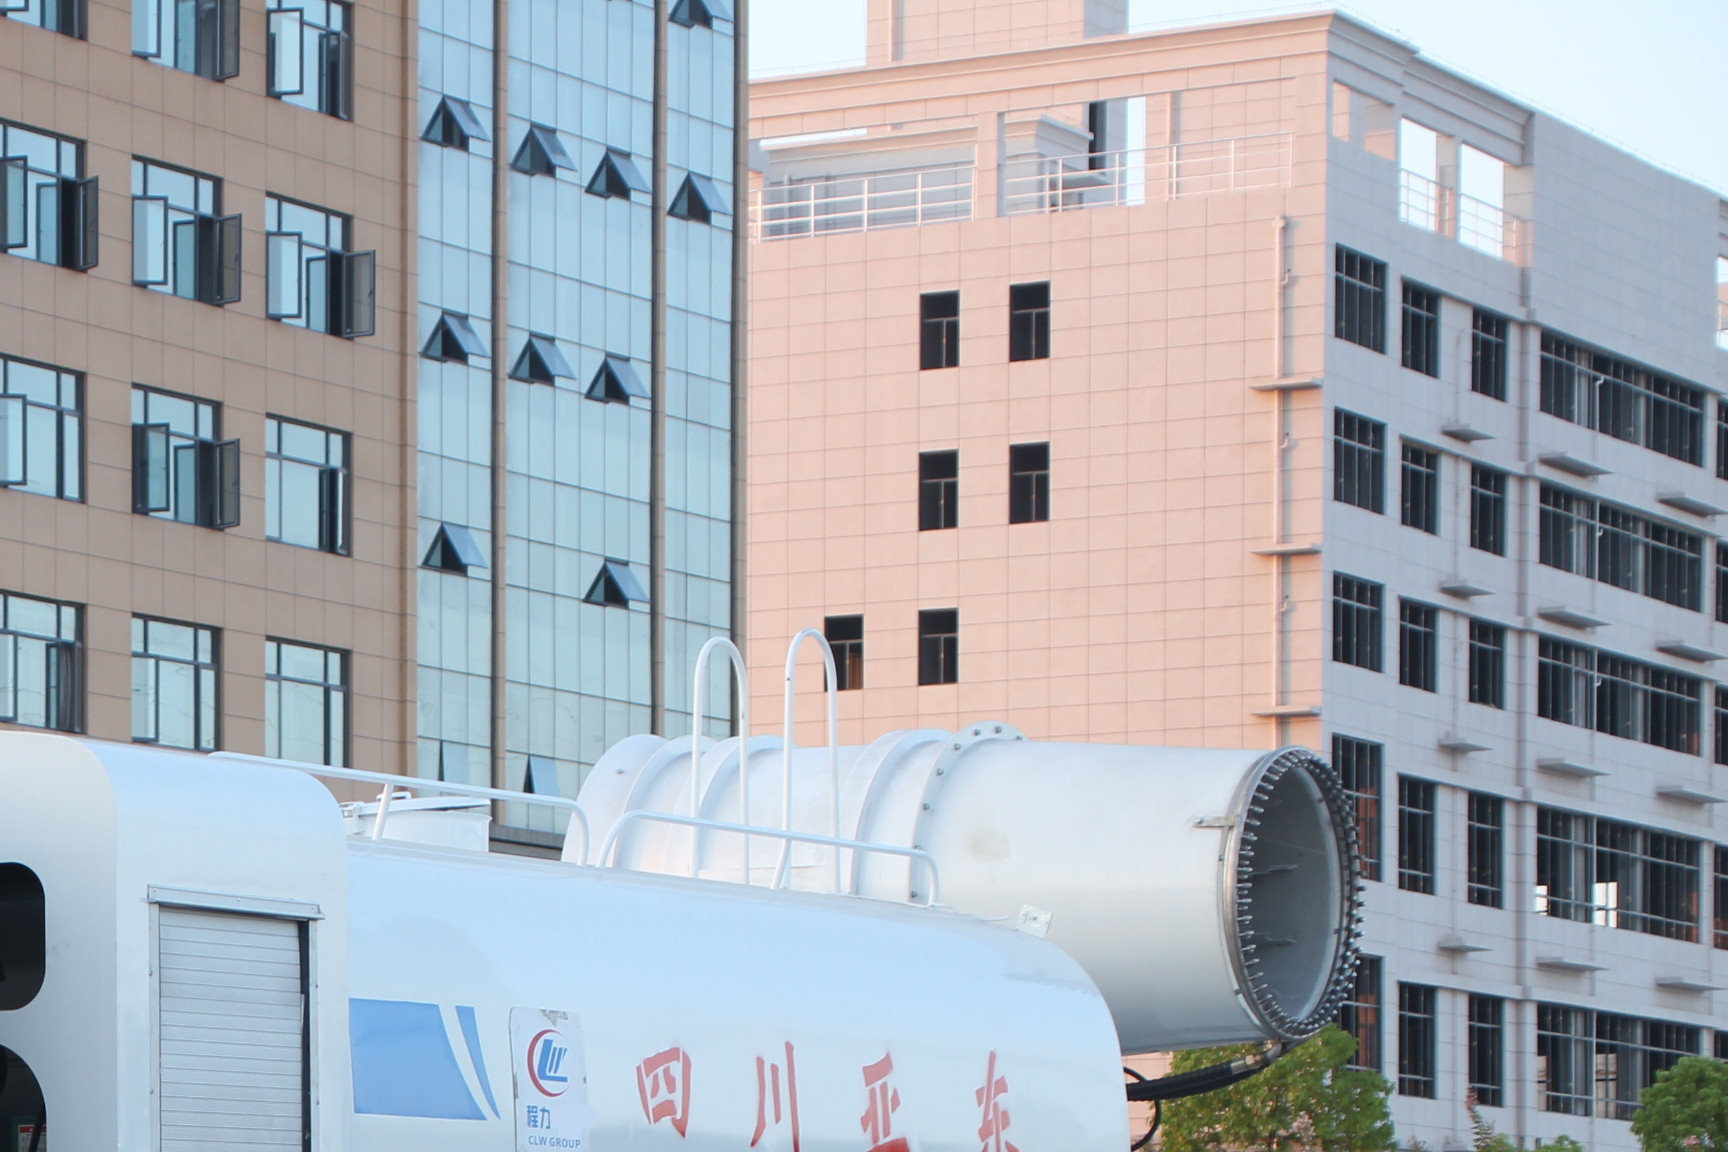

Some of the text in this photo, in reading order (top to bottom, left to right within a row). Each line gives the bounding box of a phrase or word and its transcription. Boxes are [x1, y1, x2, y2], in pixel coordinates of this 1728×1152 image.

[526, 1104, 552, 1130] 程力
[528, 1134, 582, 1149] CLW GROUP
